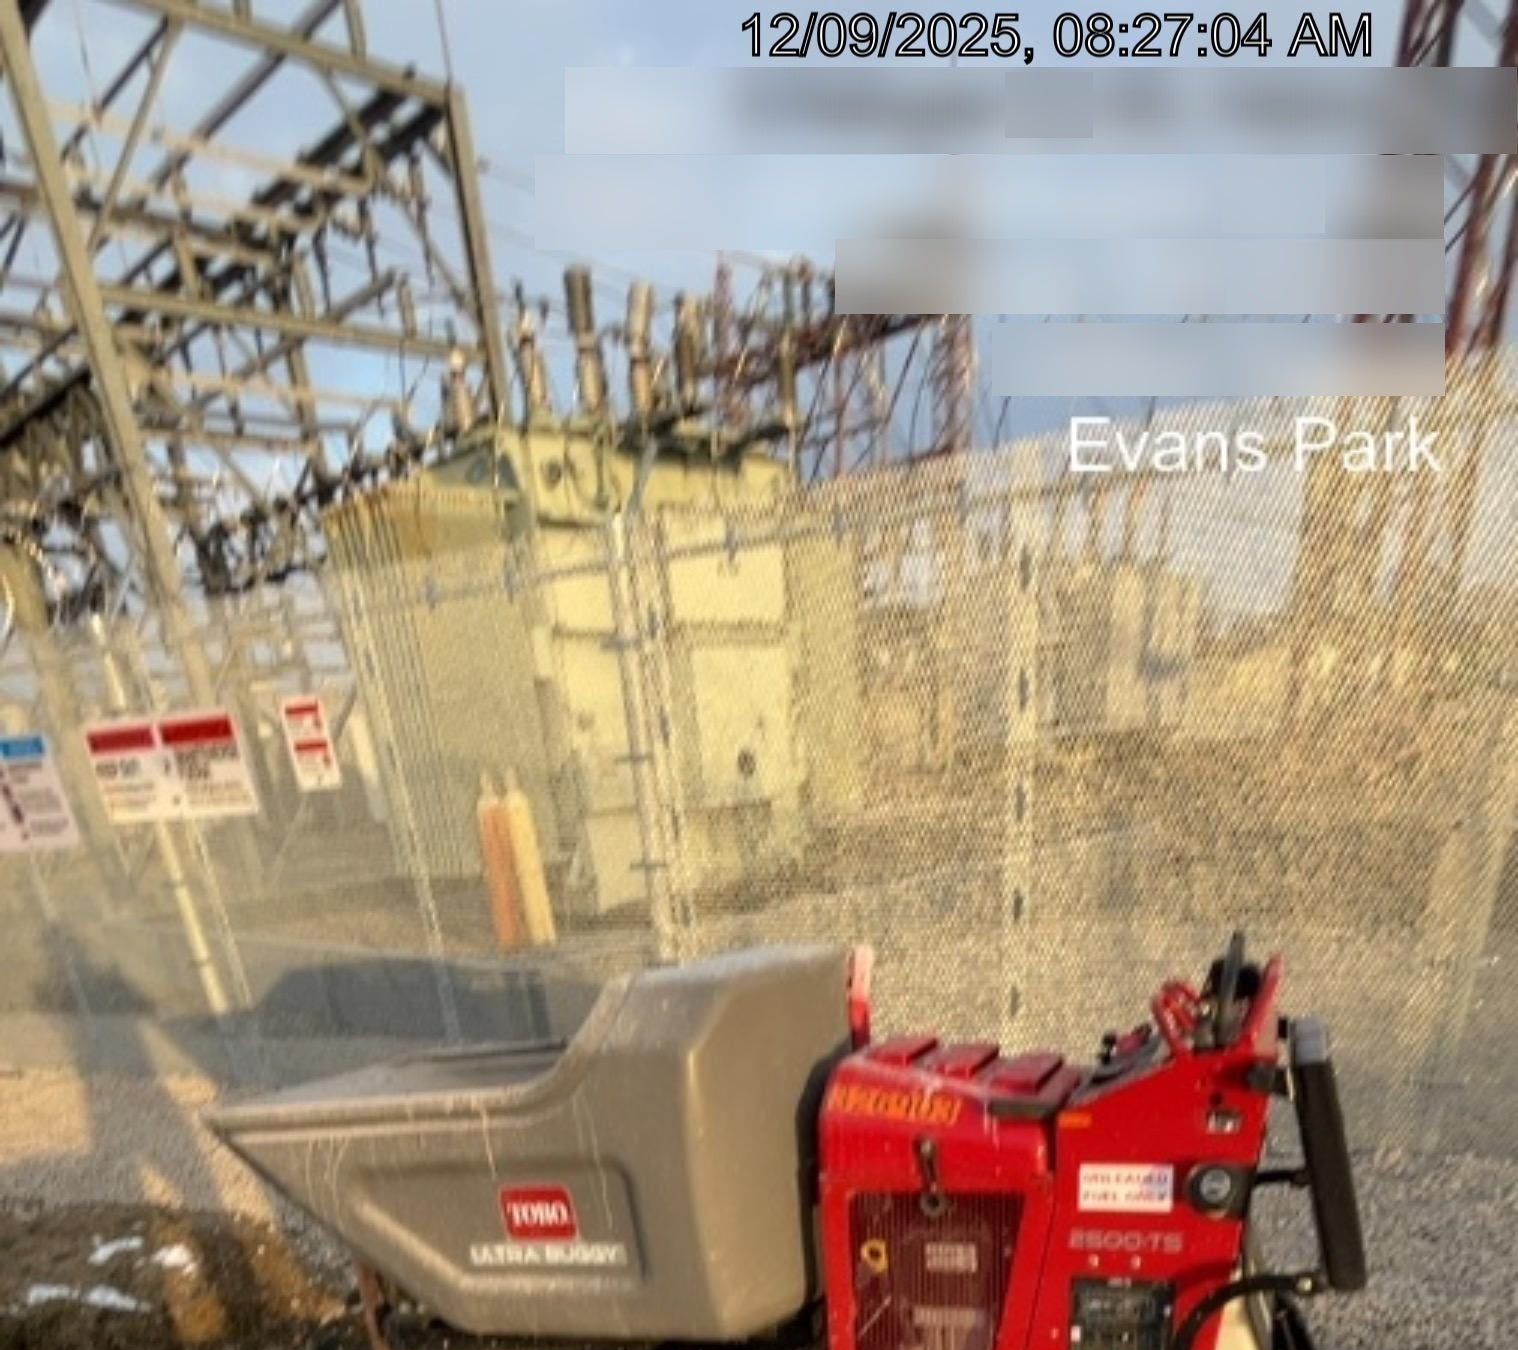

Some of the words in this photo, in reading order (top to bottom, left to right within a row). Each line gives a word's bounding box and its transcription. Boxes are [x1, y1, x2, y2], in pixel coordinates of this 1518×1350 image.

[506, 1201, 569, 1227] TORO
[469, 1245, 540, 1265] ULTRA
[545, 1245, 624, 1265] BUGGY
